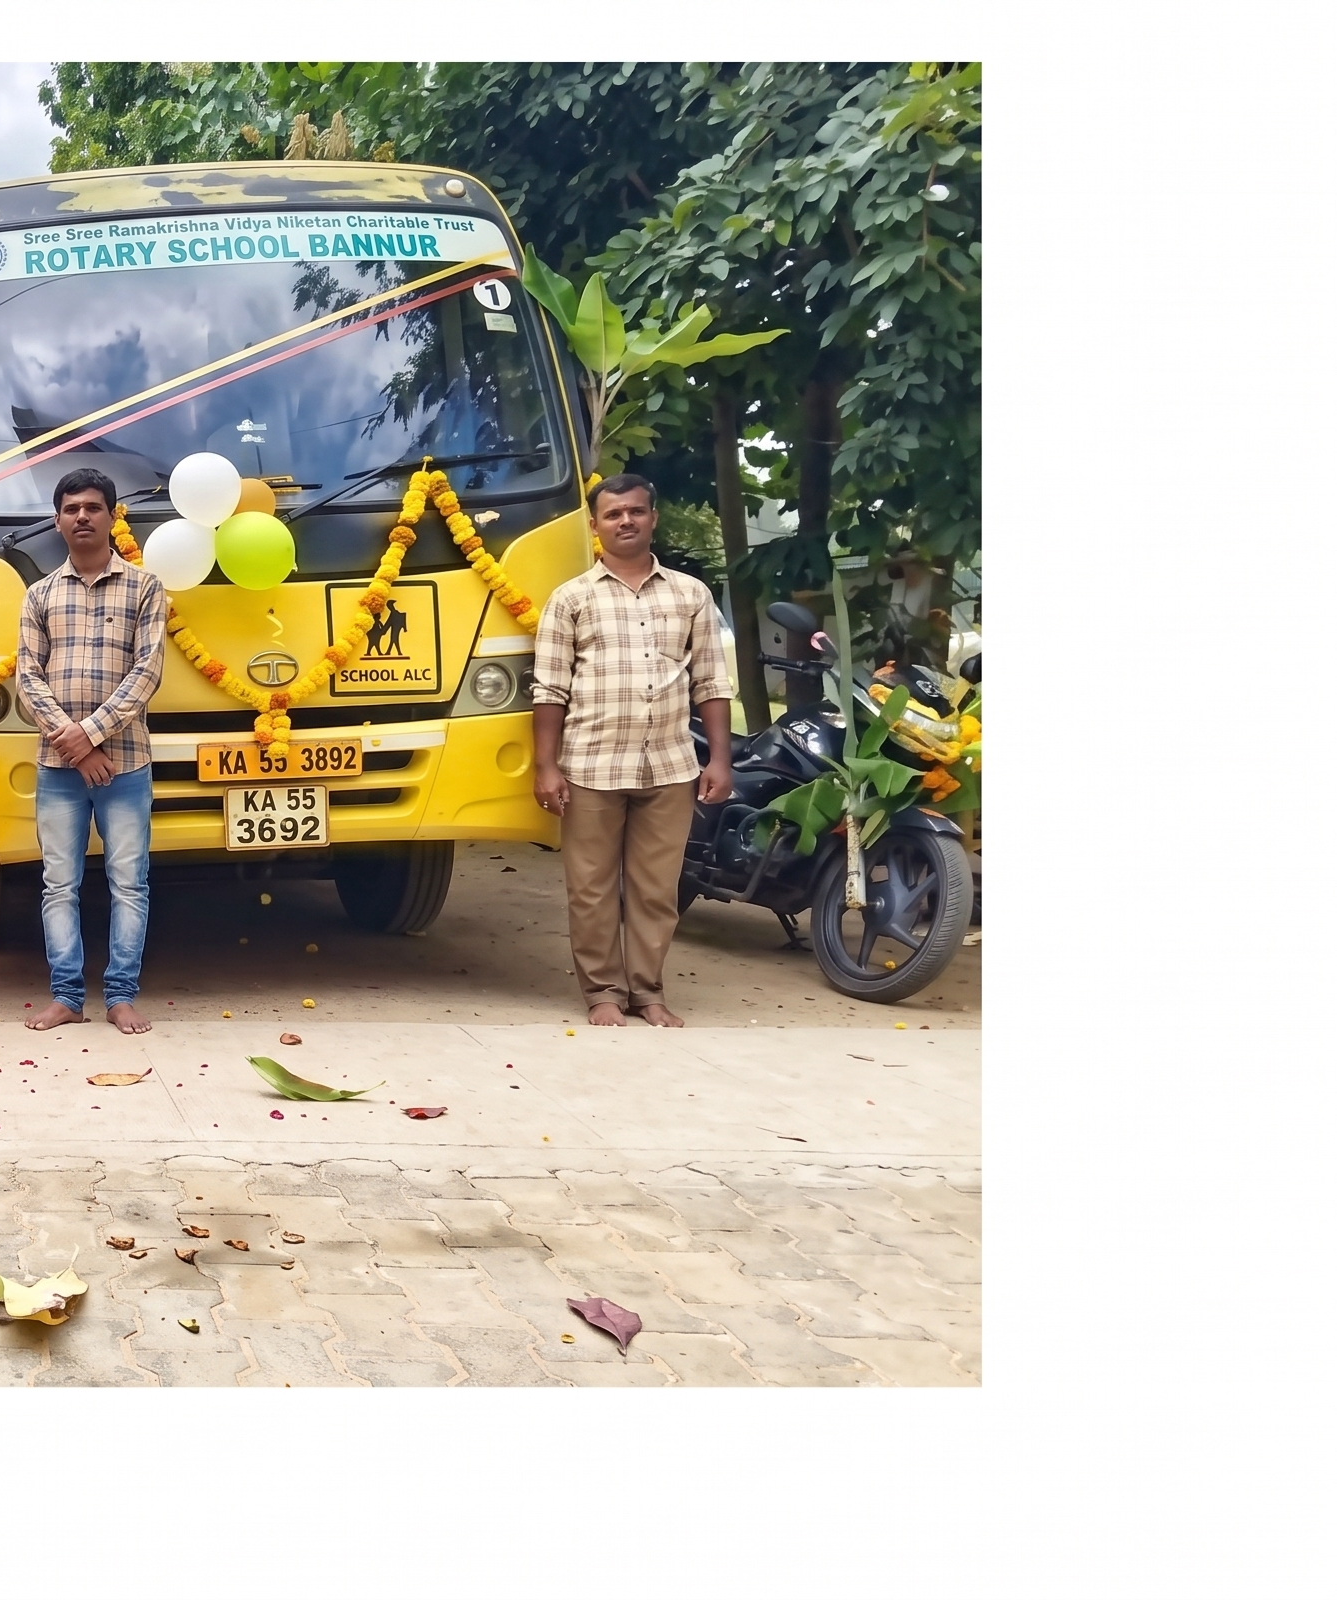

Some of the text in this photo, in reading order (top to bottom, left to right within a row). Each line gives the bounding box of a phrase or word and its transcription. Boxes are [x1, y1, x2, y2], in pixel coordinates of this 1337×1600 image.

[23, 215, 475, 245] Sree Sree Ramakrishna Vidya Niketan Charitable Trust
[25, 241, 157, 275] ROTARY
[168, 234, 300, 264] SCHOOL
[308, 233, 441, 258] BANNUR
[484, 283, 500, 306] 1
[340, 669, 399, 683] SCHOOL
[218, 750, 248, 775] KA
[300, 746, 357, 772] 3892
[243, 788, 316, 812] KA 55
[236, 815, 321, 844] 3692
